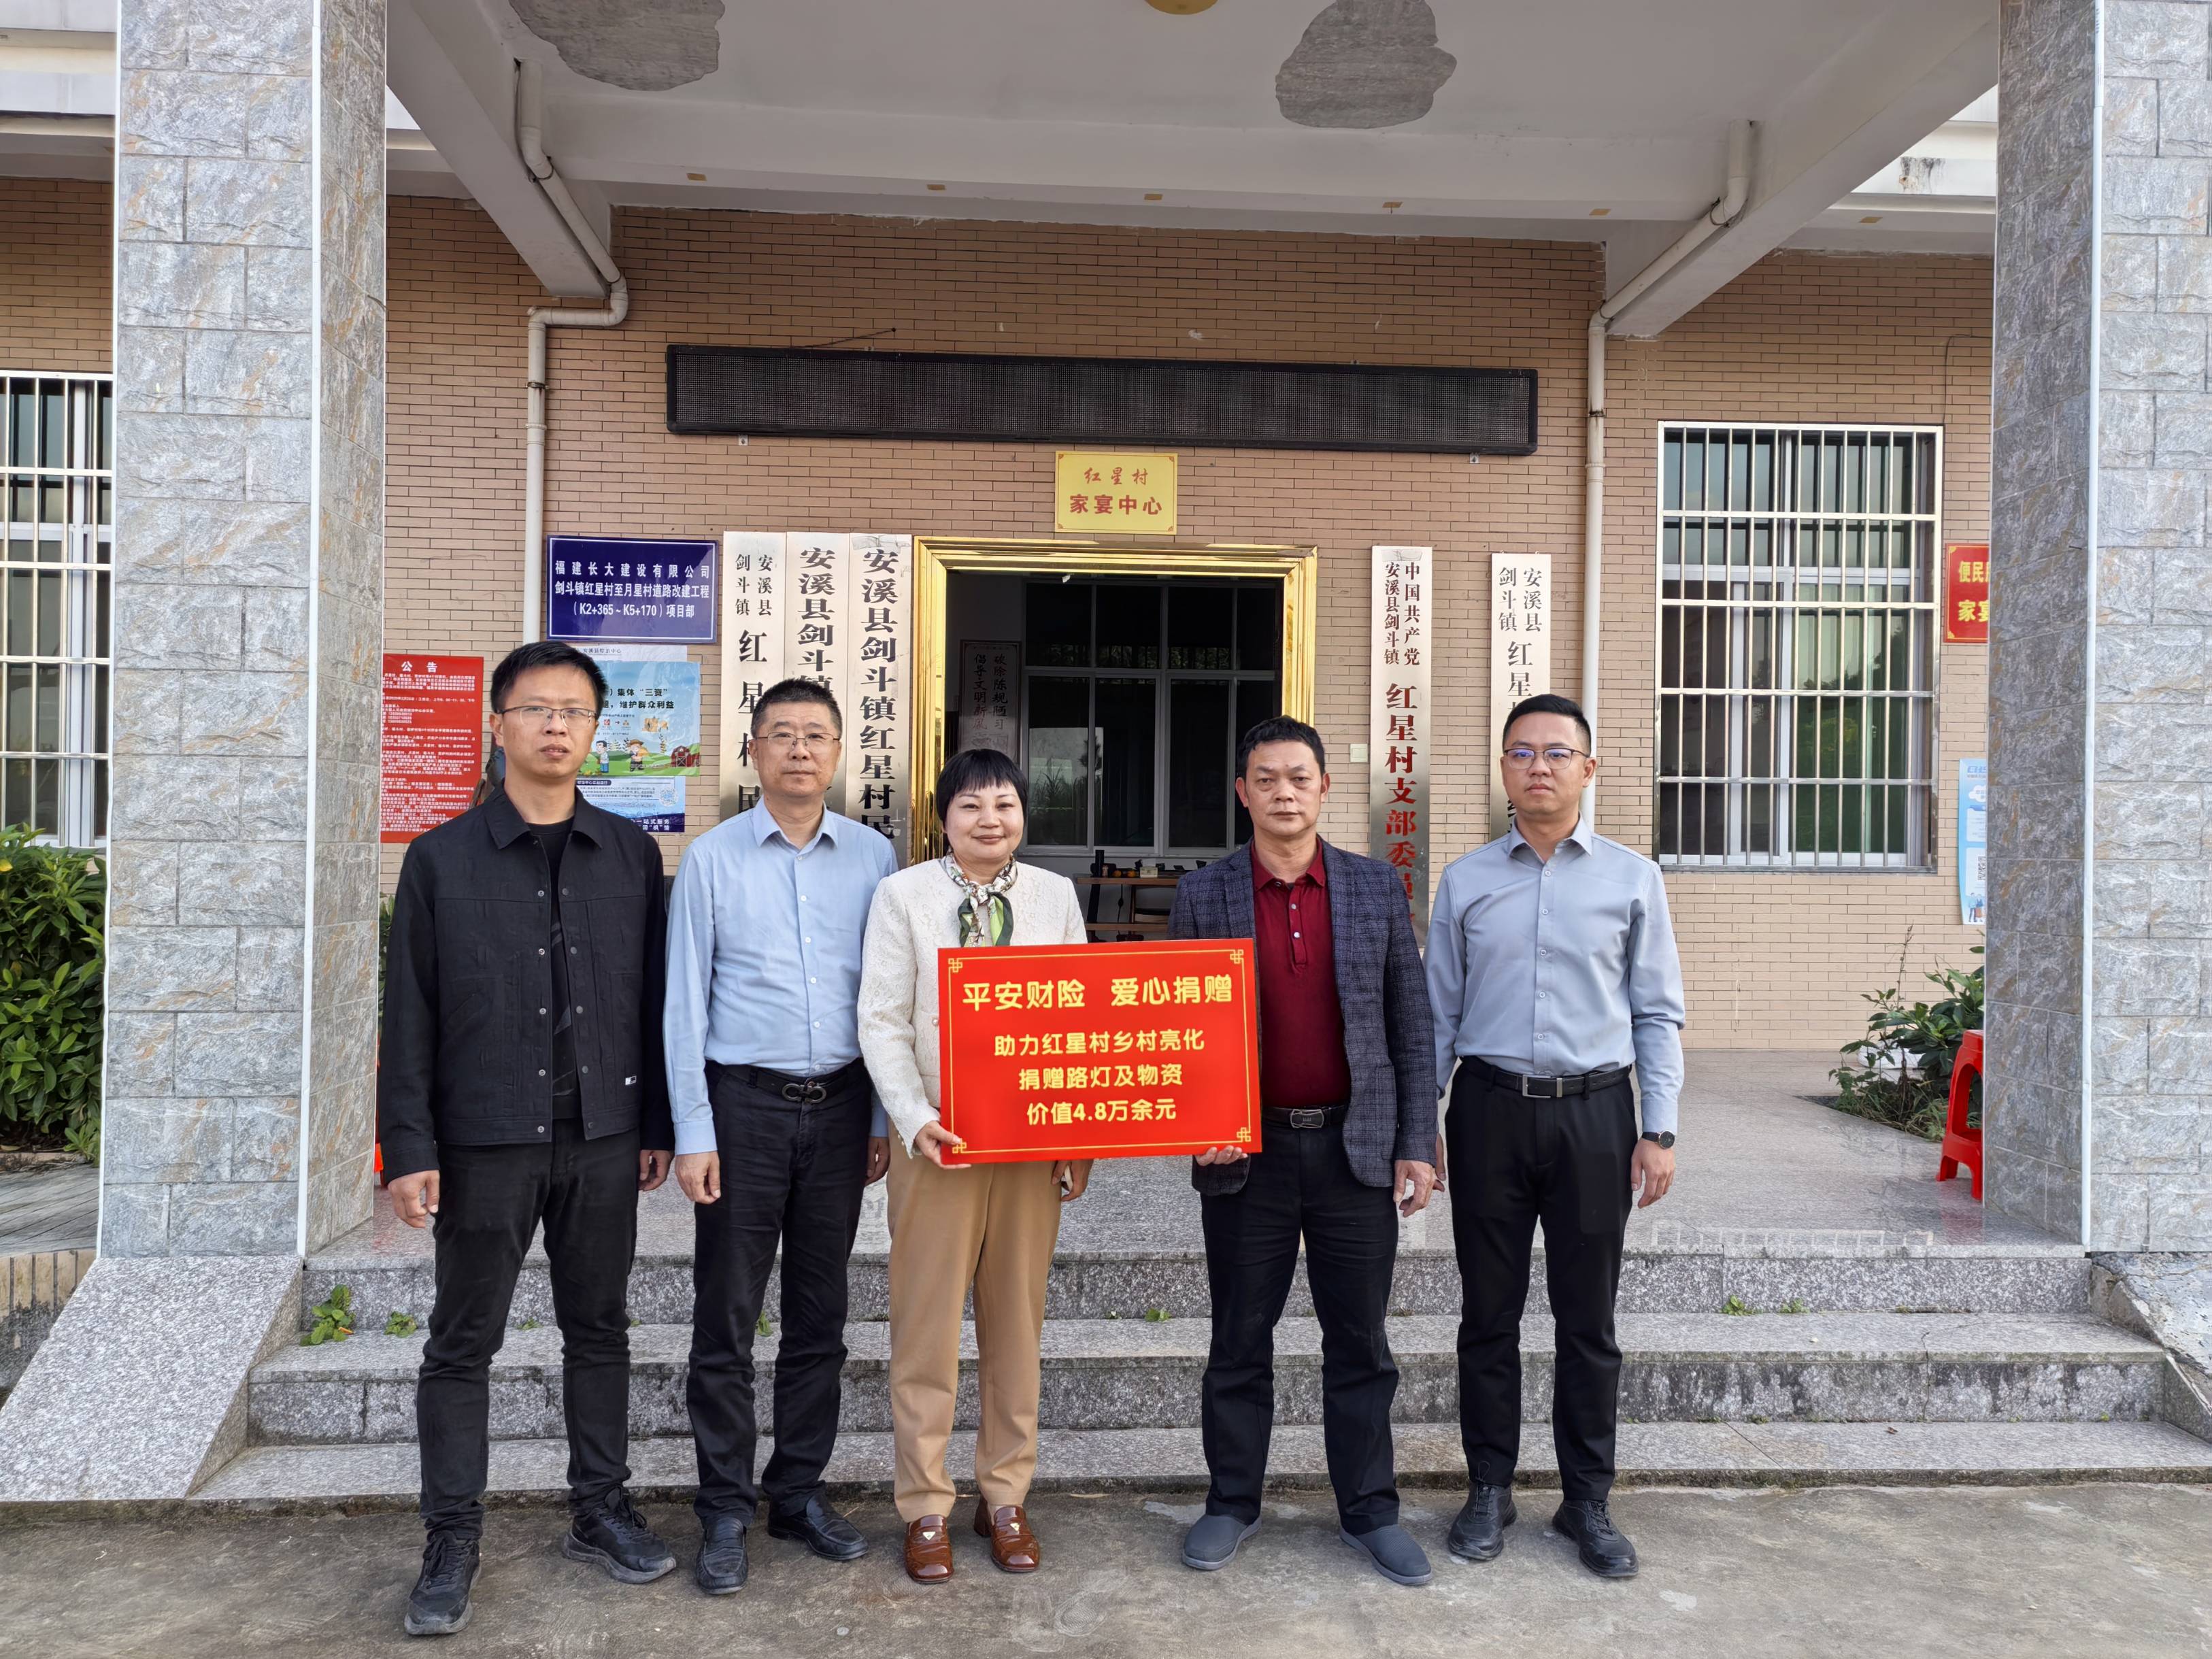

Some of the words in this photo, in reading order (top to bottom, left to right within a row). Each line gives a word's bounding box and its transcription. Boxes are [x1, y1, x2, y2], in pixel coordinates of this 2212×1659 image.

[1084, 467, 1149, 485] 红星村
[1069, 494, 1162, 515] 家宴中心
[554, 560, 710, 578] 福建长大建设有限公司
[735, 553, 750, 616] 剑斗镇
[756, 553, 773, 616] 安溪县
[1958, 560, 1990, 583] 便民
[554, 580, 710, 599] 剑斗镇红星村至月星村道路改建工程
[1498, 566, 1518, 633] 剑斗镇
[1523, 566, 1543, 633] 安溪县
[1384, 561, 1401, 665] 安溪县剑斗镇
[1404, 561, 1421, 666] 中国共产党
[401, 661, 438, 673] 公告
[1507, 641, 1533, 712] 红星
[858, 548, 899, 839] 安溪县剑斗镇红星村民
[962, 979, 1086, 1011] 平安财险
[1110, 974, 1233, 1007] 爱心捐赠
[994, 1028, 1205, 1057] 助力红星村乡村亮化
[1018, 1063, 1183, 1091] 捐赠路灯及物资
[1026, 1098, 1177, 1126] 价值4.8万余元
